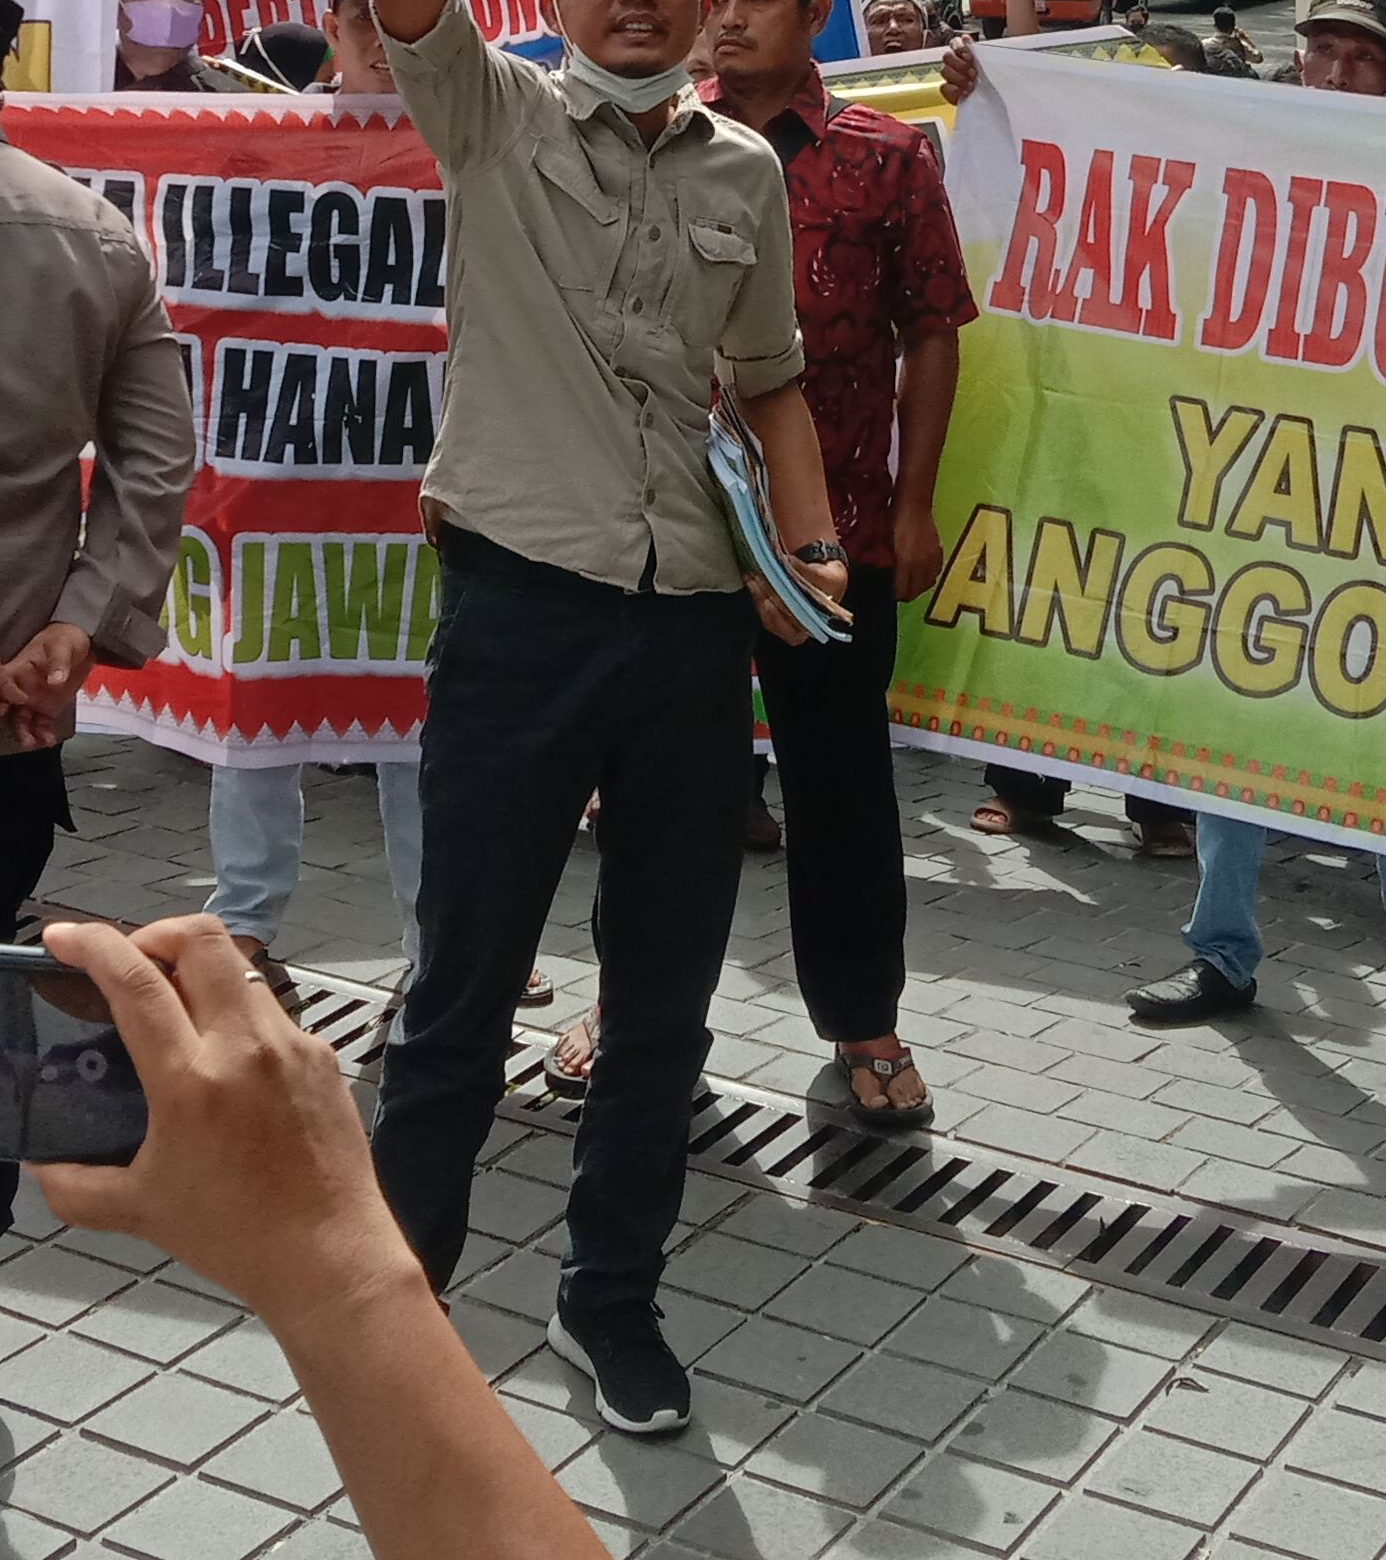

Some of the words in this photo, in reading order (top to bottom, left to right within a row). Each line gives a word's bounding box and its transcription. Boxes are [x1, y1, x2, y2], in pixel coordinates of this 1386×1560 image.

[163, 183, 446, 308] ILLEGAL
[989, 138, 1196, 340] RAK
[215, 347, 447, 466] HANA
